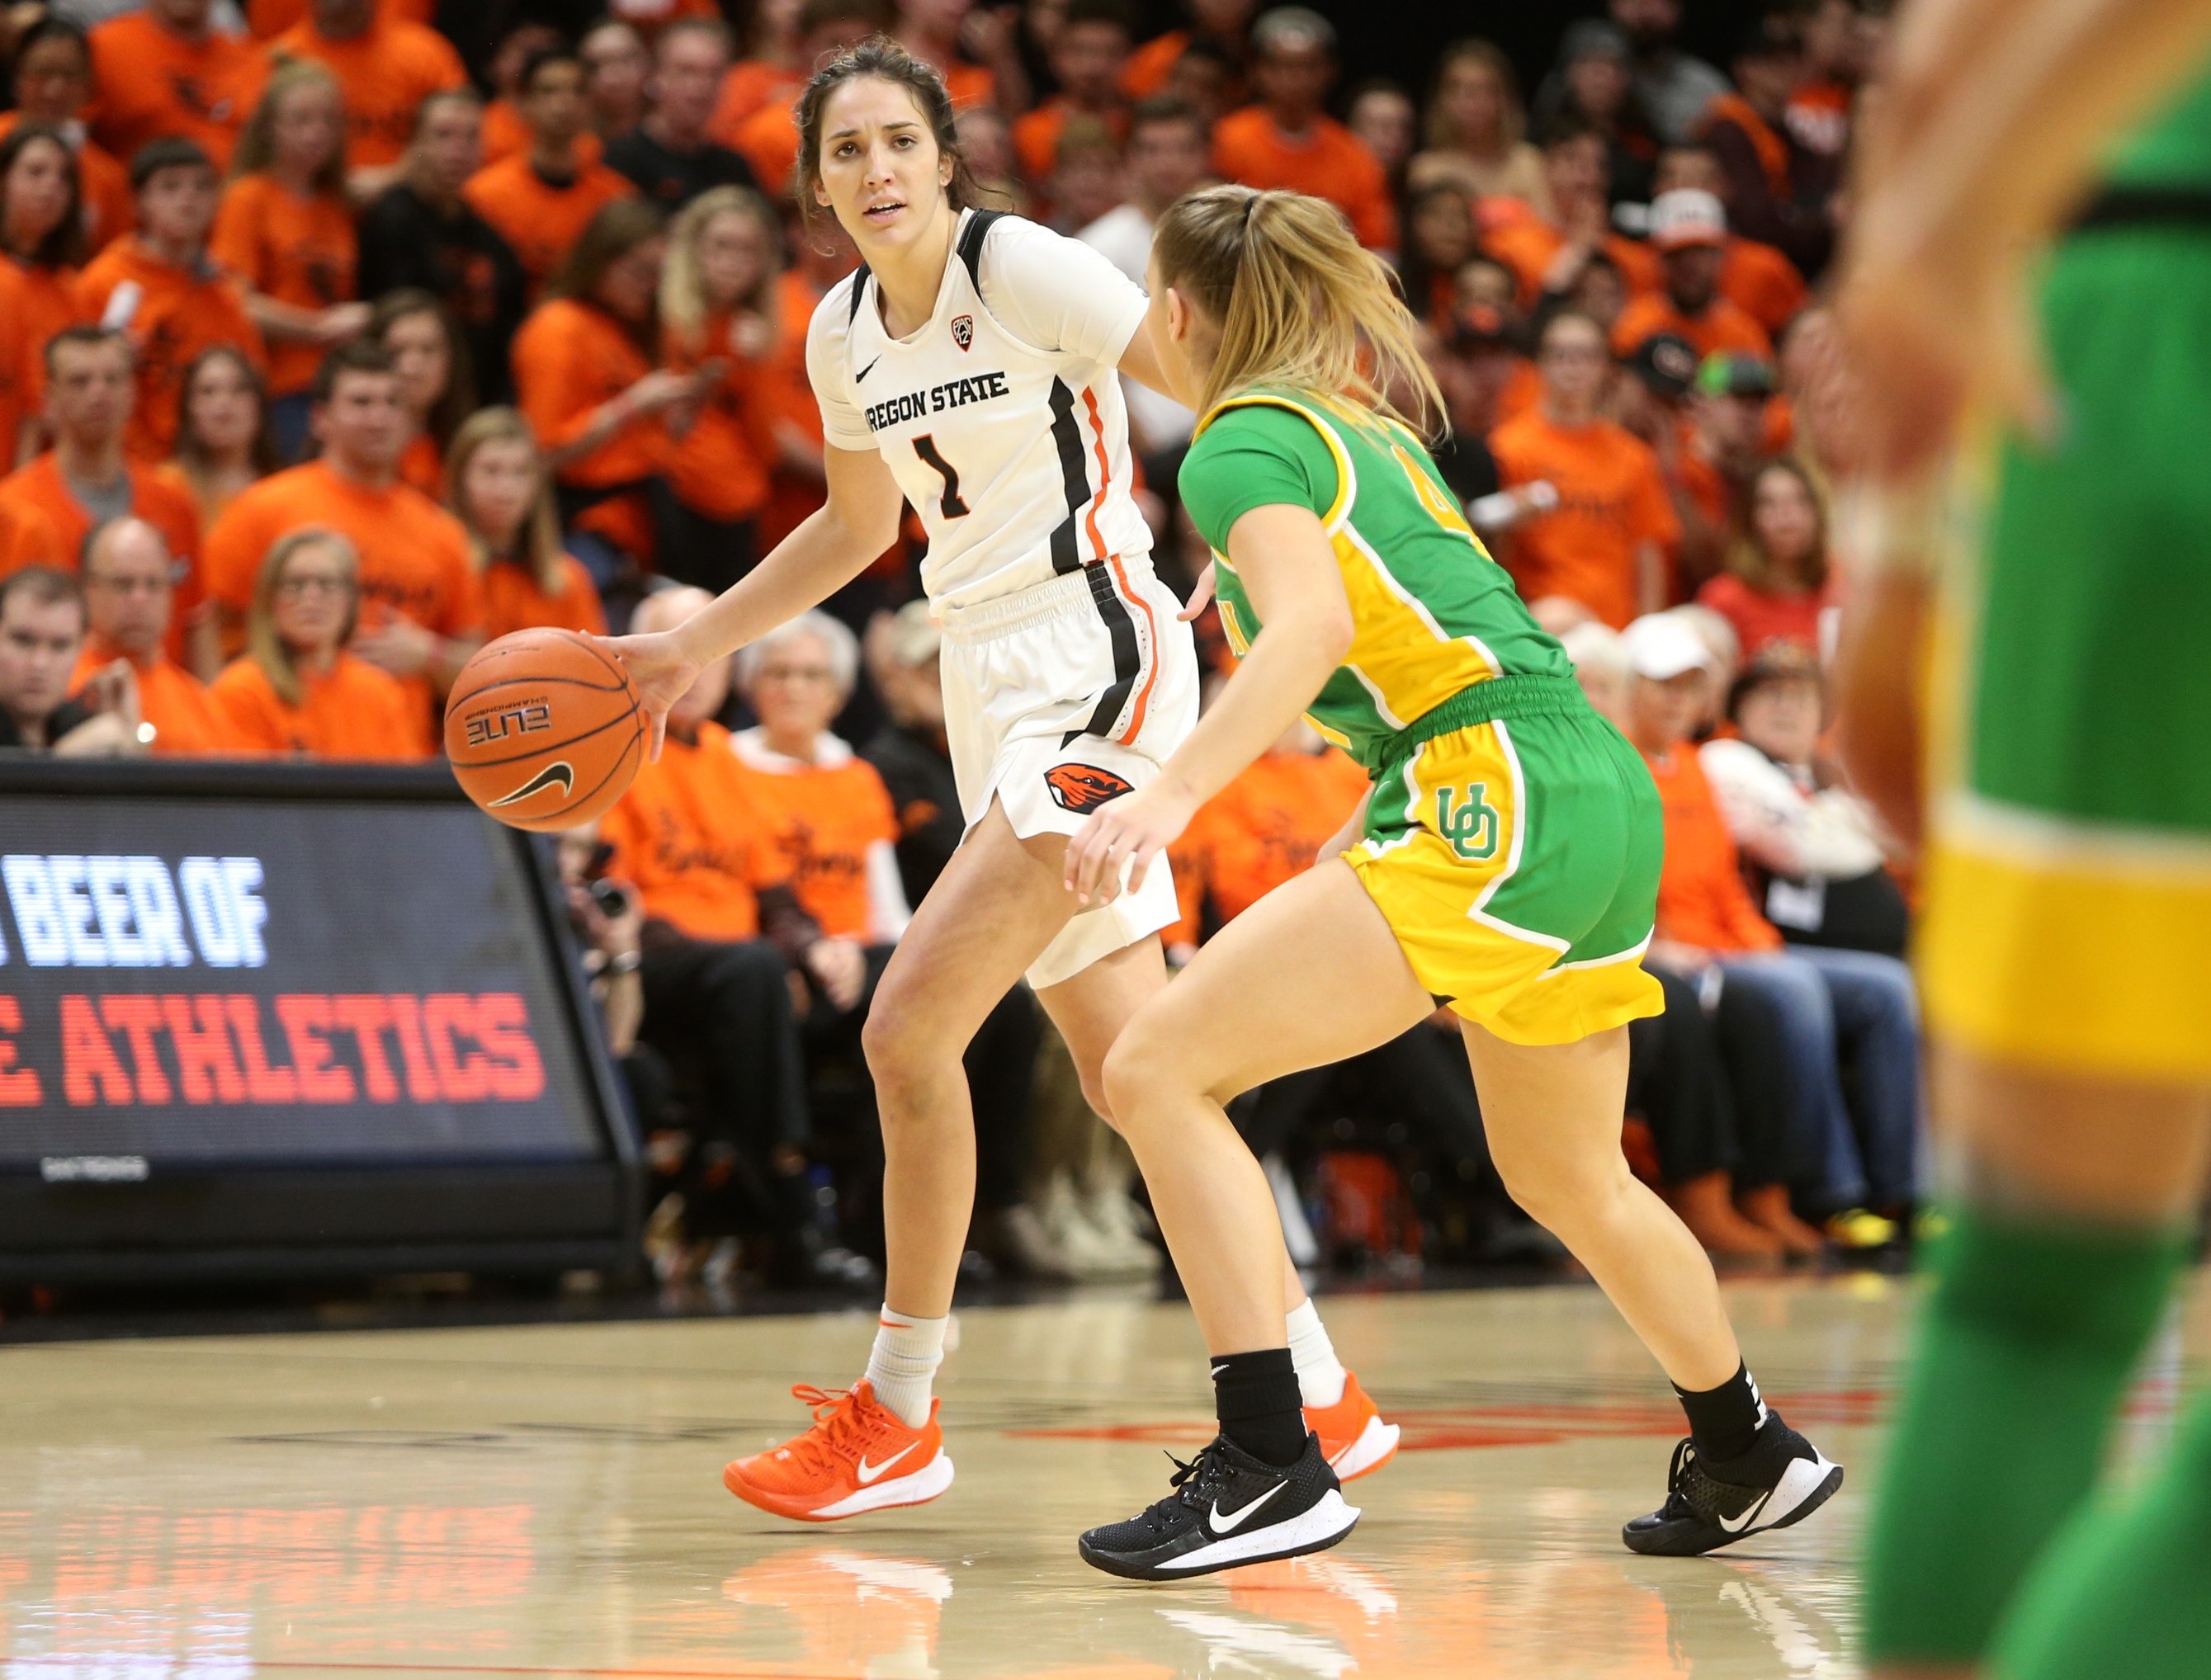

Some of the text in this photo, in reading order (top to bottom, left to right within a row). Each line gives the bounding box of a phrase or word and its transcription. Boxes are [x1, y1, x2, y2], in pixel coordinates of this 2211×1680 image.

[953, 317, 971, 339] PAC
[958, 330, 970, 345] 12
[865, 371, 1009, 432] REGON STATE
[911, 433, 971, 520] 1
[465, 696, 548, 720] CHAMPIONSHIP
[465, 704, 551, 747] ELITE
[2, 854, 194, 968] BEER
[178, 856, 270, 968] OF
[59, 992, 547, 1107] ATHLETICS
